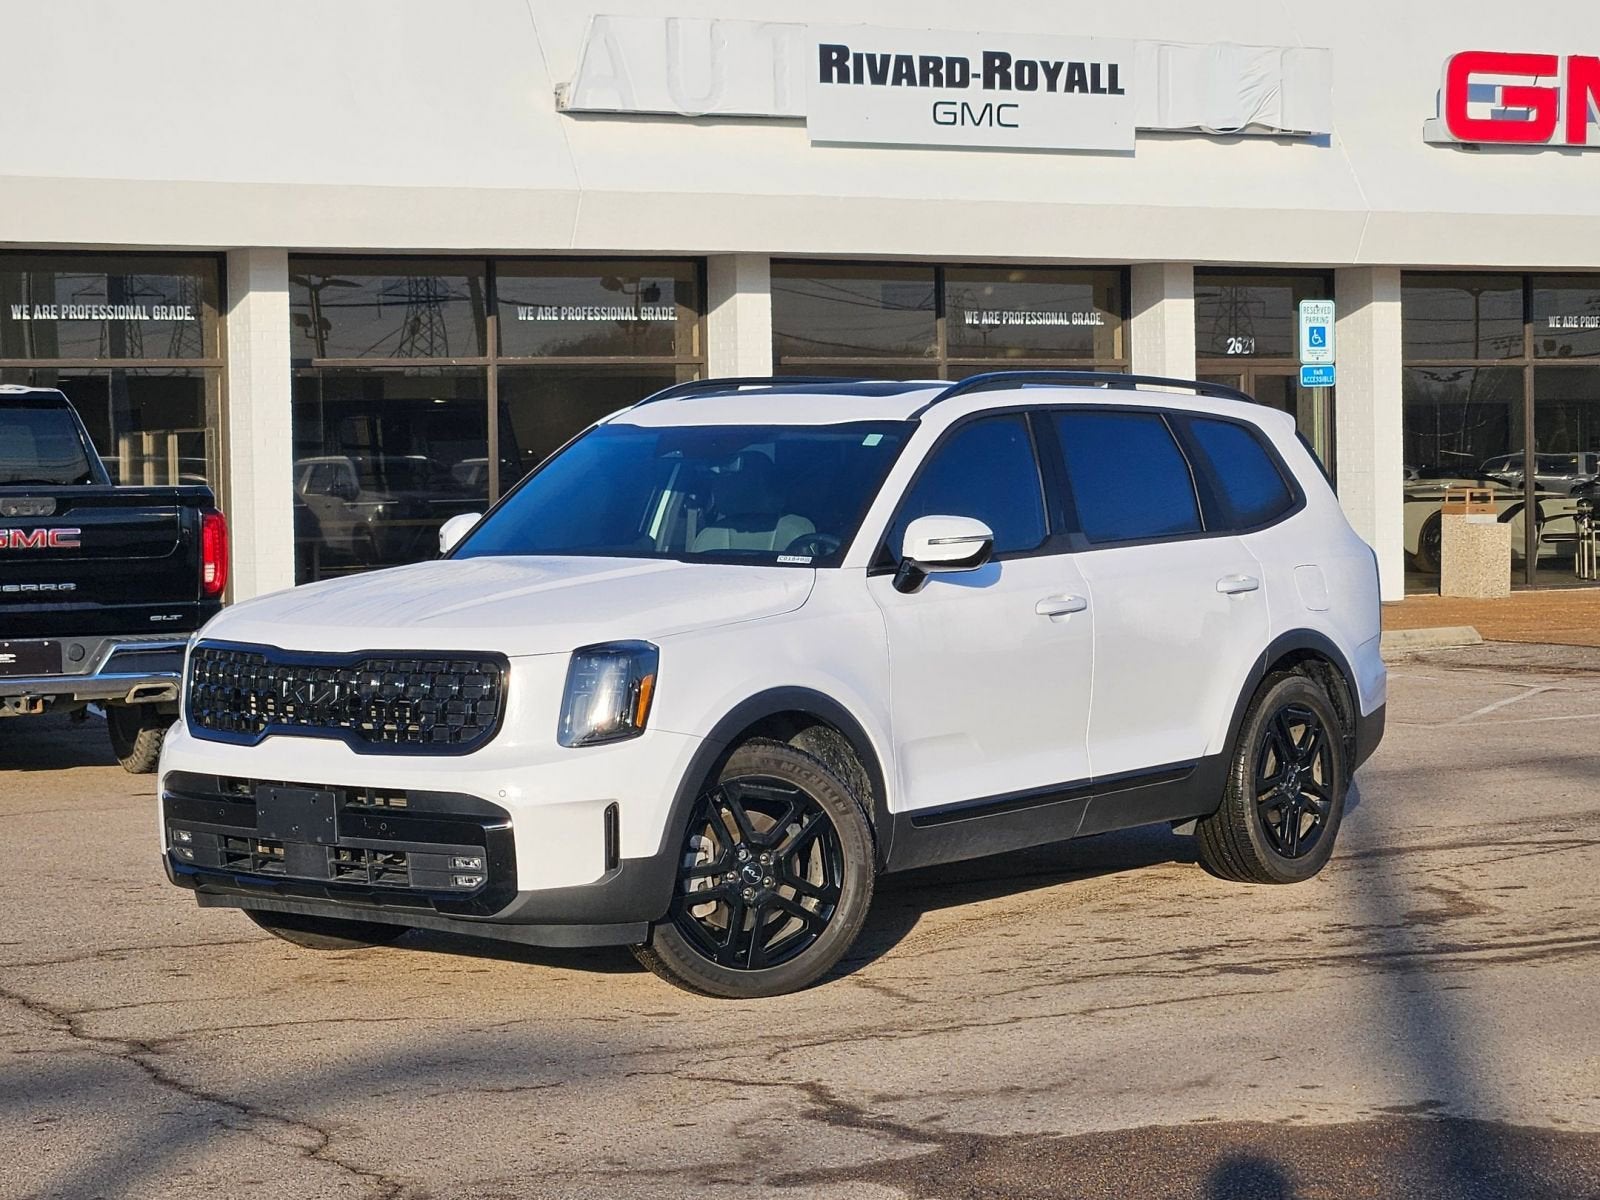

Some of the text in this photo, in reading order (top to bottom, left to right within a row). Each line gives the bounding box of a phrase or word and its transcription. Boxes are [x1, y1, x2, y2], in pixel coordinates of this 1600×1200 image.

[818, 43, 1125, 95] RIVARD-ROYALL
[932, 101, 1020, 128] GMC
[11, 304, 196, 321] WE ARE PROFESSIONAL GRADE.
[517, 306, 678, 321] WE ARE PROFESSIONAL GRADE.
[1303, 305, 1331, 315] RESERVED
[964, 310, 1104, 326] WE ARE PROFESSIONAL GRADE.
[1305, 316, 1329, 325] PARKING
[1548, 315, 1600, 328] WE ARE PROF
[1226, 336, 1255, 354] 2621
[1303, 375, 1333, 383] ACCESSIBLE
[0, 528, 81, 548] MC
[0, 583, 77, 592] ERRA
